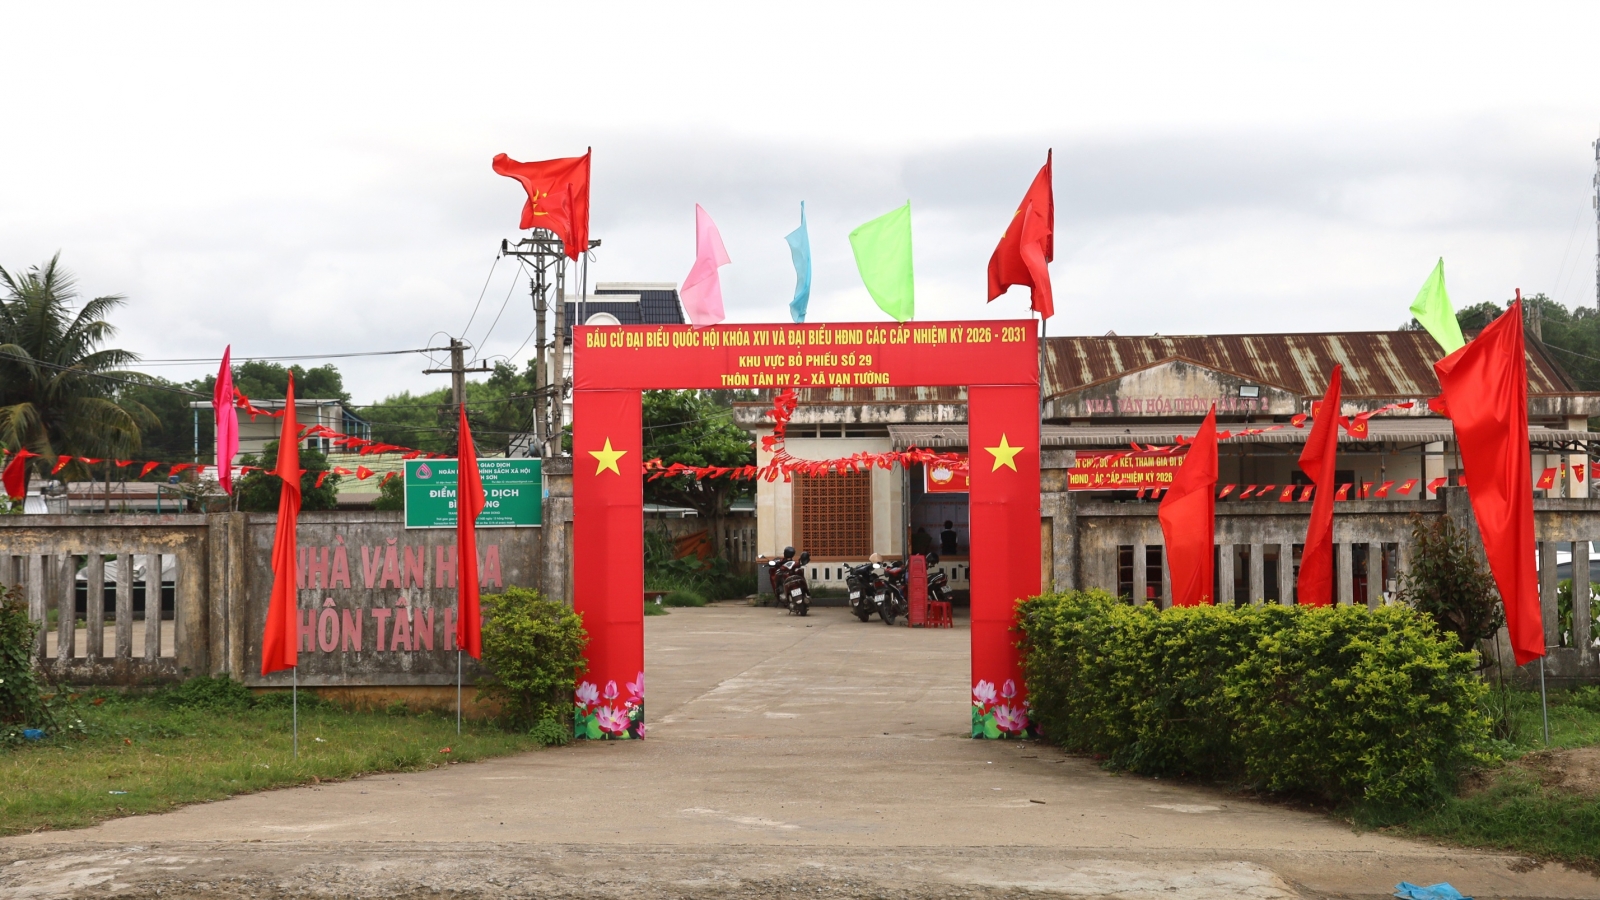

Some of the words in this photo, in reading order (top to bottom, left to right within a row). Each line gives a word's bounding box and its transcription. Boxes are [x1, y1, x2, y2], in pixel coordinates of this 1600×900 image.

[586, 327, 606, 348] BẦU
[610, 327, 624, 347] CỬ
[626, 331, 643, 350] ĐẠI
[647, 326, 669, 347] BIỂU
[672, 326, 699, 347] QUỐC
[703, 329, 720, 350] HỘI
[723, 328, 750, 346] KHÓA
[753, 330, 769, 346] XVI
[772, 327, 786, 345] VÀ
[788, 329, 805, 349] ĐẠI
[808, 323, 832, 345] BIỂU
[835, 329, 863, 345] HĐND
[866, 325, 887, 345] CÁC
[889, 323, 911, 345] CẤP
[913, 325, 947, 347] NHIỆM
[950, 325, 964, 344] KỲ
[966, 328, 992, 343] 2026
[1002, 326, 1026, 343] 2031
[739, 355, 761, 367] KHU
[764, 355, 785, 369] VỰC
[788, 352, 803, 367] BỎ
[806, 350, 838, 366] PHIẾU
[841, 350, 856, 366] SỐ
[859, 354, 872, 366] 29
[721, 373, 749, 386] THÔN
[752, 372, 773, 385] TÂN
[776, 374, 790, 385] HY
[793, 374, 801, 385] 2
[811, 371, 826, 385] XÃ
[829, 373, 851, 387] VẠN
[854, 371, 889, 384] TƯỜNG
[1085, 395, 1114, 413] NHÀ
[1117, 395, 1143, 413] VĂN
[1146, 394, 1172, 413] HÓA
[1175, 394, 1208, 412] THÔN
[1211, 394, 1238, 411] TÂN
[1261, 396, 1269, 411] 2
[1135, 457, 1155, 467] THAM
[1156, 456, 1168, 467] GIA
[1169, 456, 1177, 466] ĐI
[520, 467, 531, 475] HỘI
[1070, 473, 1089, 485] HĐND
[1146, 471, 1155, 483] KỲ
[1156, 472, 1173, 483] 2026
[429, 486, 456, 498] ĐIỂM
[491, 489, 519, 499] DỊCH
[361, 537, 425, 589] VĂN
[435, 544, 503, 589] HA
[297, 597, 363, 653] HÔN
[371, 596, 435, 652] TÂN
